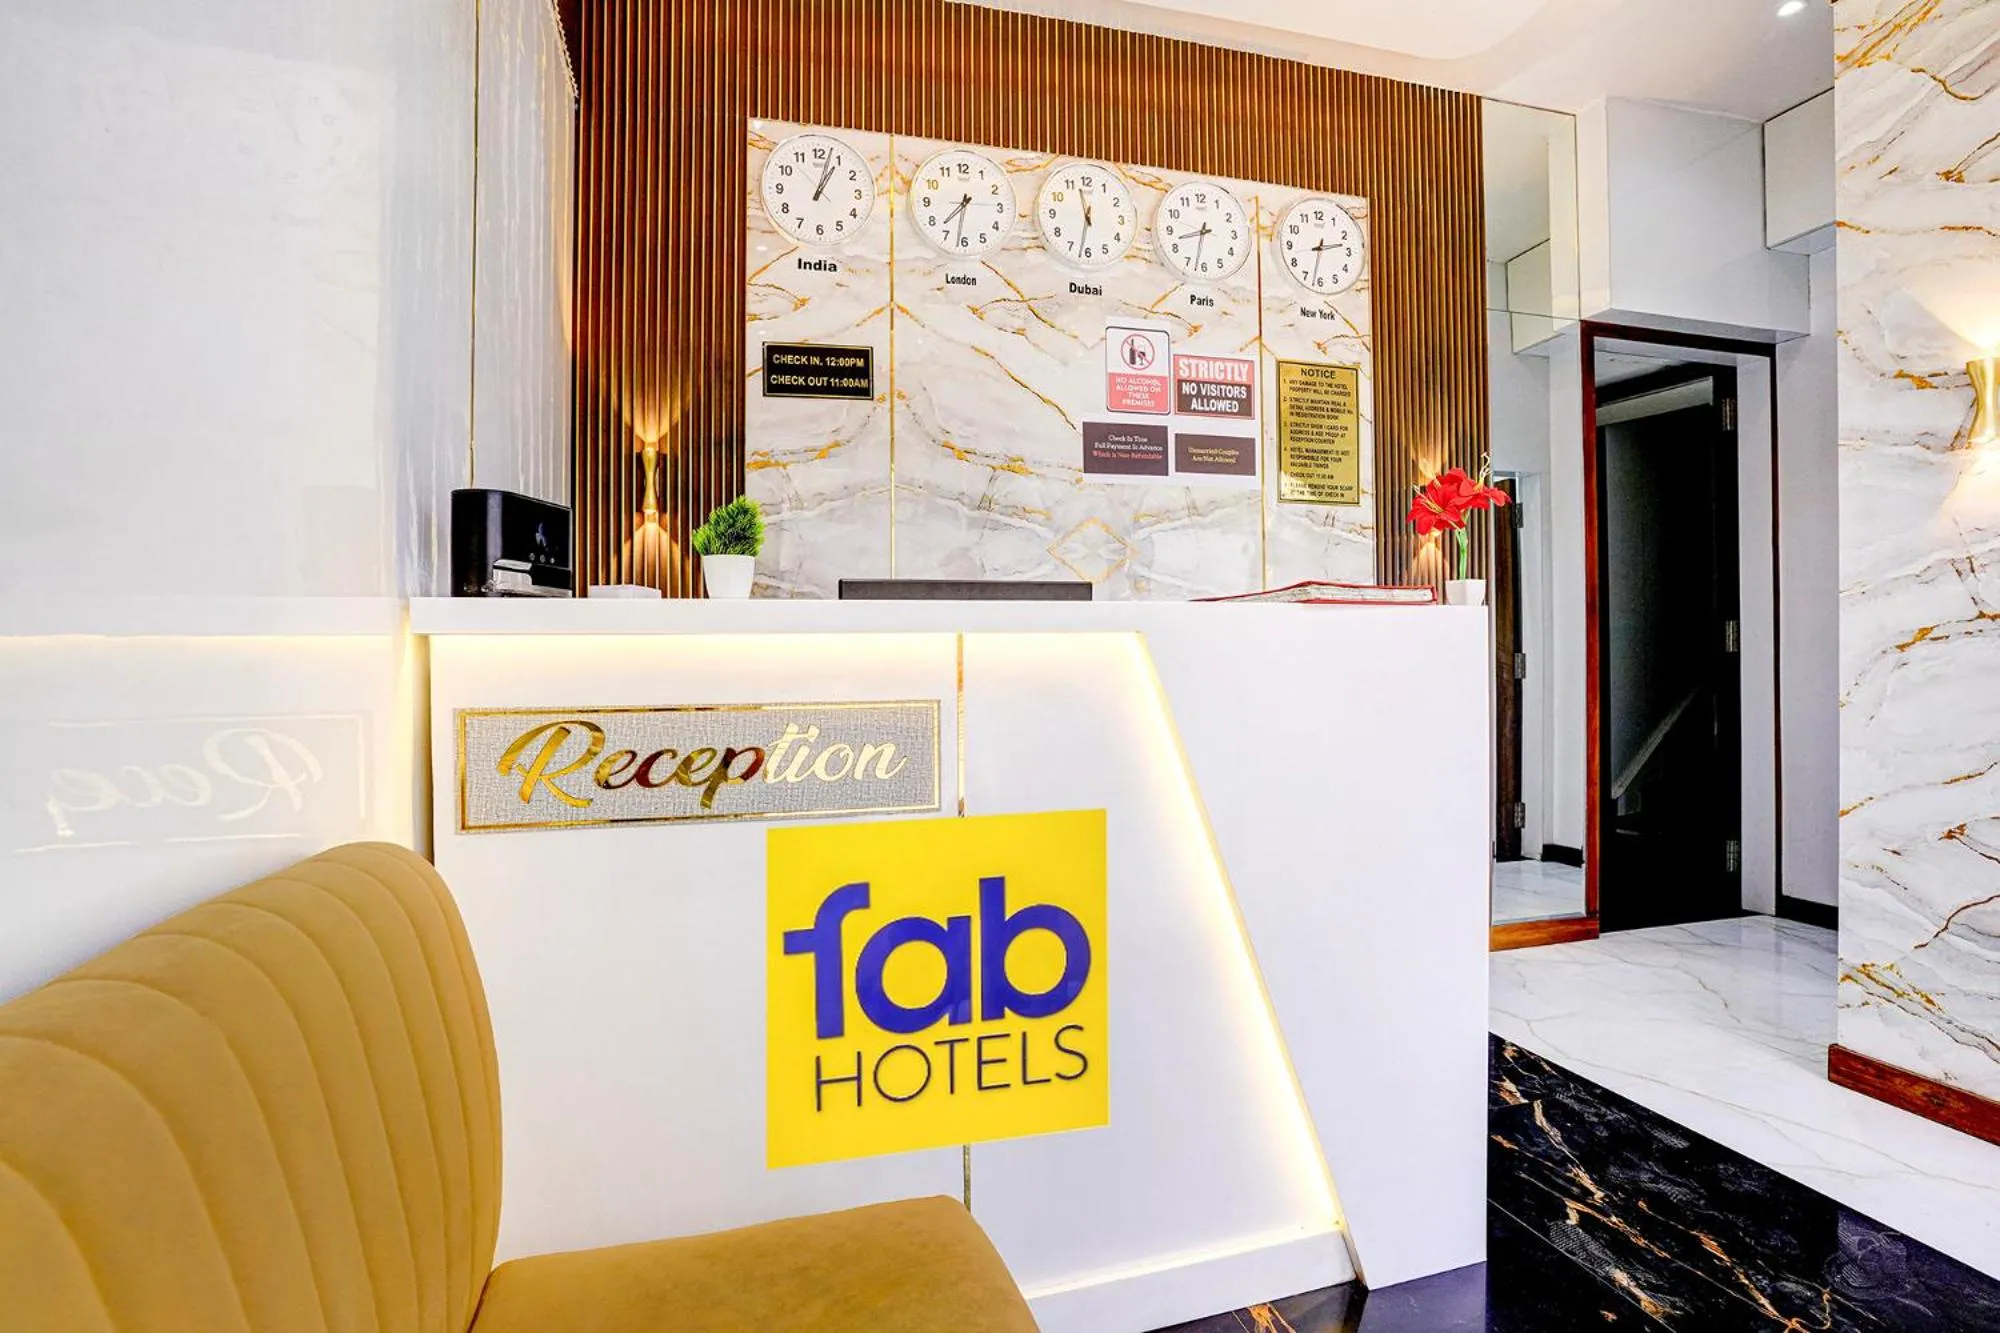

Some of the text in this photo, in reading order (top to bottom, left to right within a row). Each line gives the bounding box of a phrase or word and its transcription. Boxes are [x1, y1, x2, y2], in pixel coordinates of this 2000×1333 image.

[794, 152, 805, 163] 11
[812, 148, 826, 159] 12
[836, 156, 841, 165] 1
[779, 165, 792, 176] 10
[940, 167, 950, 177] 11
[957, 164, 969, 174] 12
[849, 170, 857, 180] 2
[978, 170, 984, 180] 1
[926, 179, 939, 190] 10
[1065, 180, 1074, 189] 11
[1080, 176, 1092, 187] 12
[776, 183, 784, 194] 9
[991, 185, 998, 195] 2
[1102, 184, 1107, 193] 1
[854, 189, 862, 200] 3
[1052, 192, 1064, 202] 10
[1195, 194, 1206, 203] 12
[923, 197, 930, 207] 9
[1113, 197, 1120, 207] 2
[1181, 197, 1190, 207] 11
[1215, 200, 1220, 209] 1
[781, 203, 790, 213] 8
[849, 208, 857, 218] 4
[997, 203, 1004, 213] 3
[1049, 209, 1056, 219] 9
[1168, 209, 1180, 219] 10
[1226, 213, 1232, 223] 2
[1300, 214, 1309, 223] 11
[1314, 211, 1324, 220] 12
[796, 218, 804, 228] 7
[929, 216, 936, 226] 8
[1118, 215, 1125, 225] 3
[1331, 217, 1336, 226] 1
[816, 225, 824, 235] 6
[836, 221, 843, 231] 5
[992, 221, 999, 231] 4
[1166, 226, 1173, 235] 9
[1290, 225, 1299, 235] 10
[942, 230, 950, 240] 7
[1054, 227, 1061, 237] 8
[1114, 232, 1120, 242] 4
[1231, 230, 1237, 240] 3
[1341, 230, 1347, 240] 2
[961, 237, 968, 247] 6
[980, 233, 987, 243] 5
[1067, 241, 1074, 251] 7
[1102, 244, 1108, 254] 5
[1172, 244, 1179, 253] 8
[1286, 240, 1292, 250] 9
[1085, 248, 1092, 258] 6
[1228, 247, 1234, 256] 4
[1346, 248, 1352, 257] 3
[798, 258, 837, 272] India
[1184, 257, 1191, 266] 7
[1217, 259, 1223, 268] 5
[1291, 258, 1298, 267] 8
[1201, 262, 1207, 272] 6
[1343, 264, 1348, 273] 4
[945, 273, 976, 286] London
[1302, 271, 1308, 280] 7
[1332, 274, 1338, 284] 5
[1317, 277, 1324, 287] 6
[1069, 282, 1102, 296] Dubai
[1190, 294, 1214, 307] Paris
[1301, 307, 1335, 320] New York
[773, 354, 808, 365] CHECK
[825, 357, 864, 367] 12:00PM
[1179, 359, 1248, 381] STRICTLY
[1301, 368, 1336, 379] NOTICE
[770, 375, 868, 388] CHECK OUT 11:00AM
[1182, 382, 1247, 398] NO VISITORS
[1191, 398, 1238, 412] ALLOWED
[496, 720, 907, 810] Reception
[783, 876, 1091, 1040] fab
[815, 1024, 1088, 1112] HOTELS
